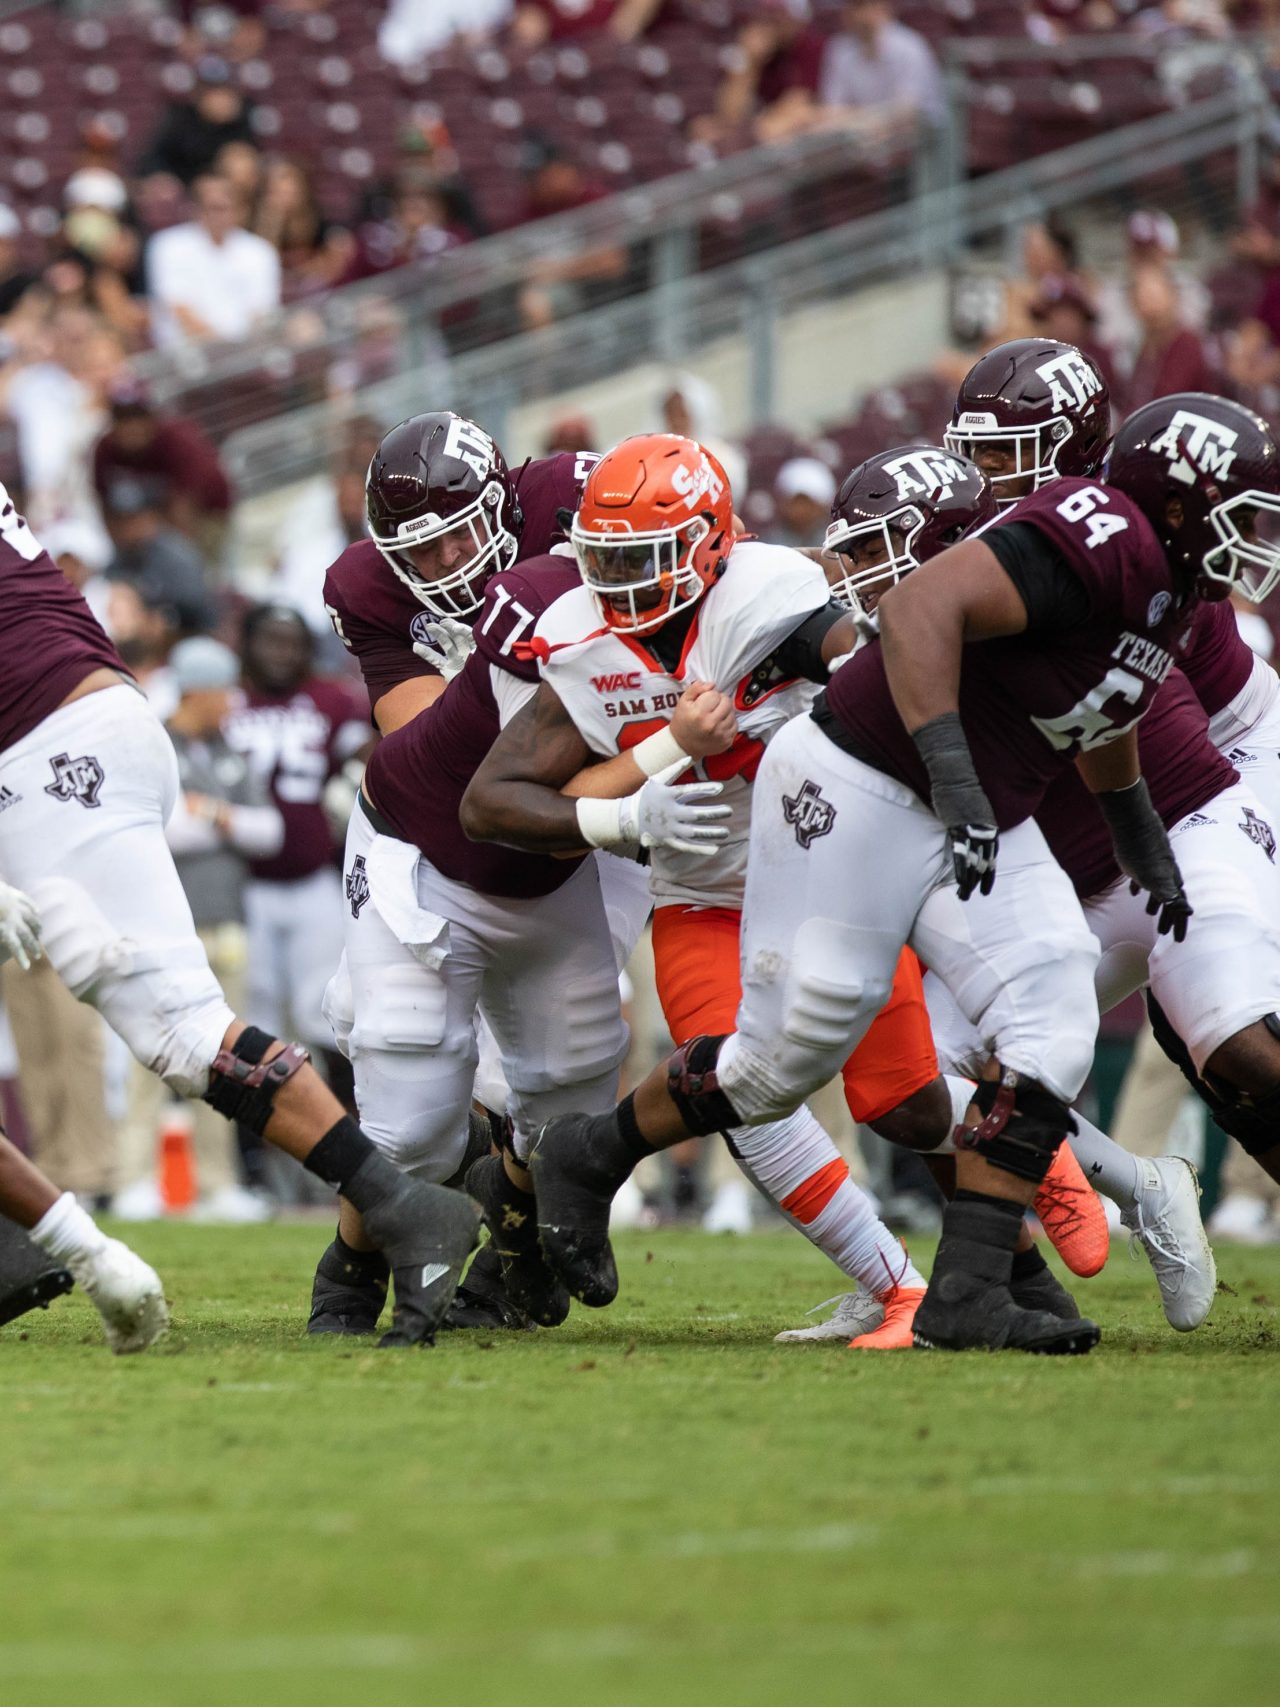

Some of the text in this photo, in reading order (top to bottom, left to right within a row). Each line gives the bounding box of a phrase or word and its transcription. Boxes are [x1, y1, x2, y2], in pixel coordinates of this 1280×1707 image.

[965, 416, 985, 424] AGGIES
[405, 519, 430, 532] AGGIES
[1056, 486, 1128, 549] 64
[481, 584, 534, 656] 77
[591, 671, 640, 693] WAC
[605, 695, 648, 718] SAM
